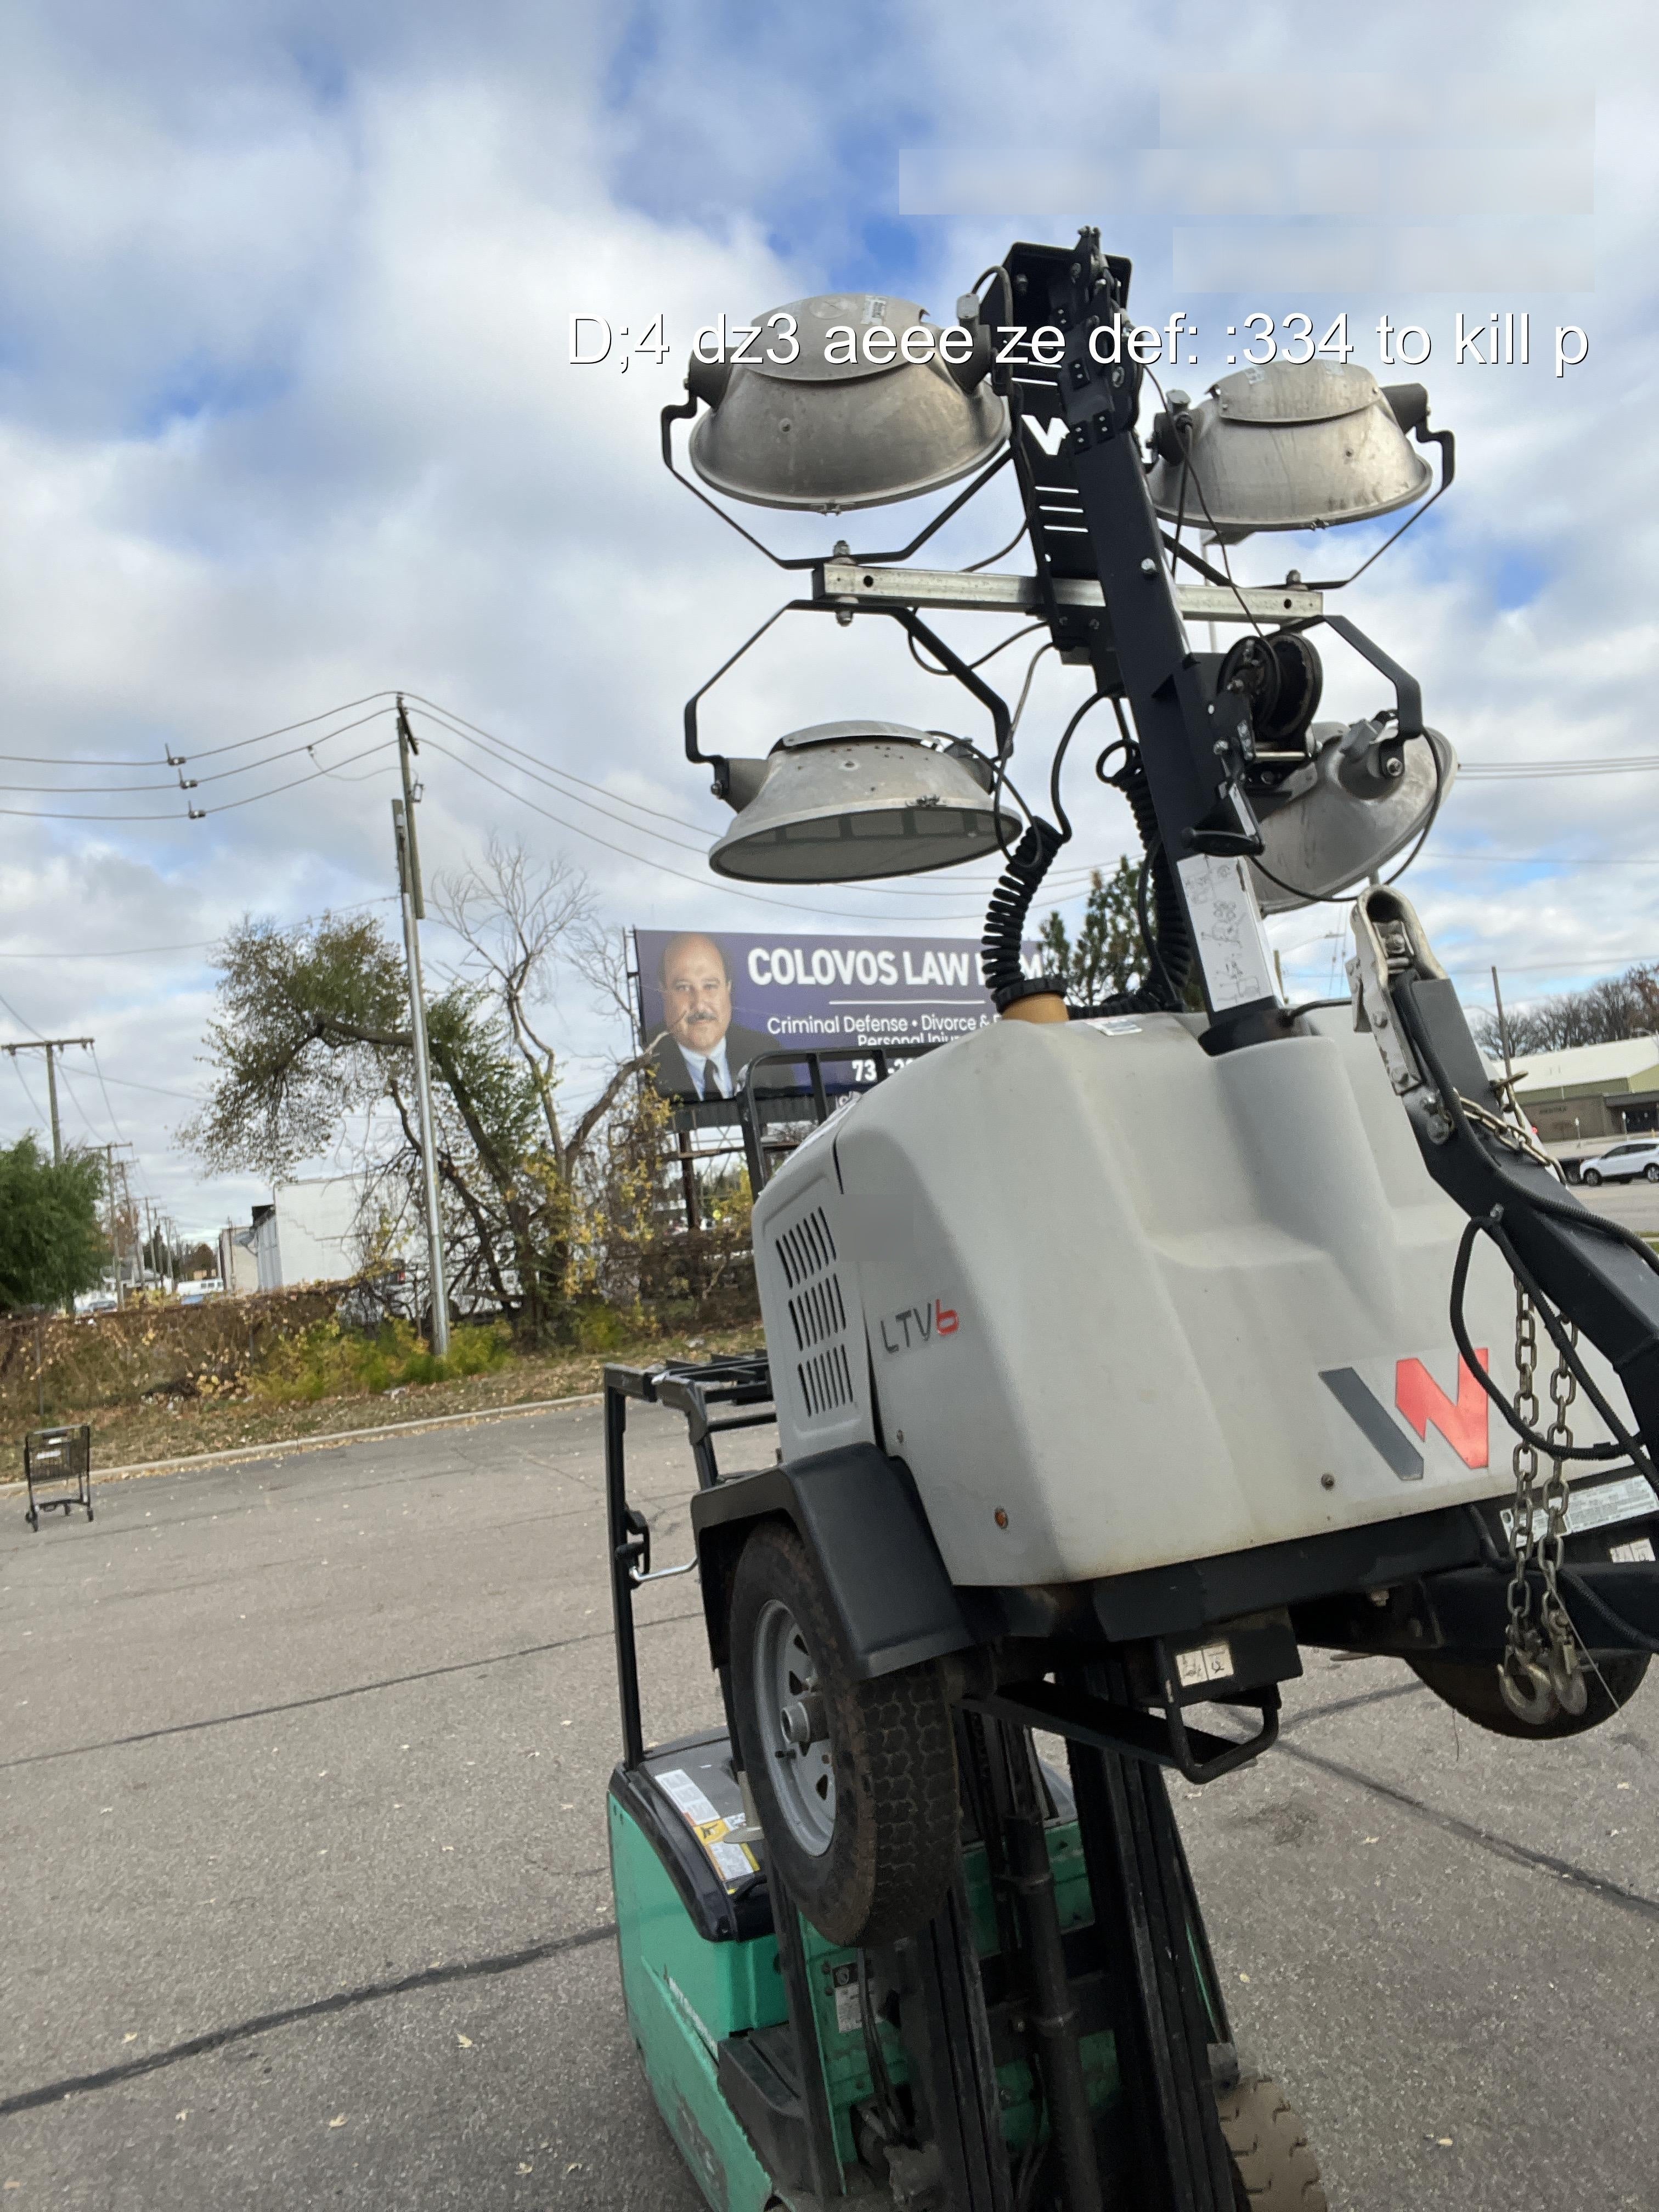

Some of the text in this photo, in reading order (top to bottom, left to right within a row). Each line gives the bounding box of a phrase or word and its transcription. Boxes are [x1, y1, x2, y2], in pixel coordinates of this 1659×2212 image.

[748, 947, 899, 985] COLOVOS
[902, 951, 970, 986] LAW
[767, 1015, 840, 1035] Criminal
[843, 1014, 909, 1033] Defense
[921, 1013, 977, 1031] Divorce
[880, 1298, 961, 1353] LTV6
